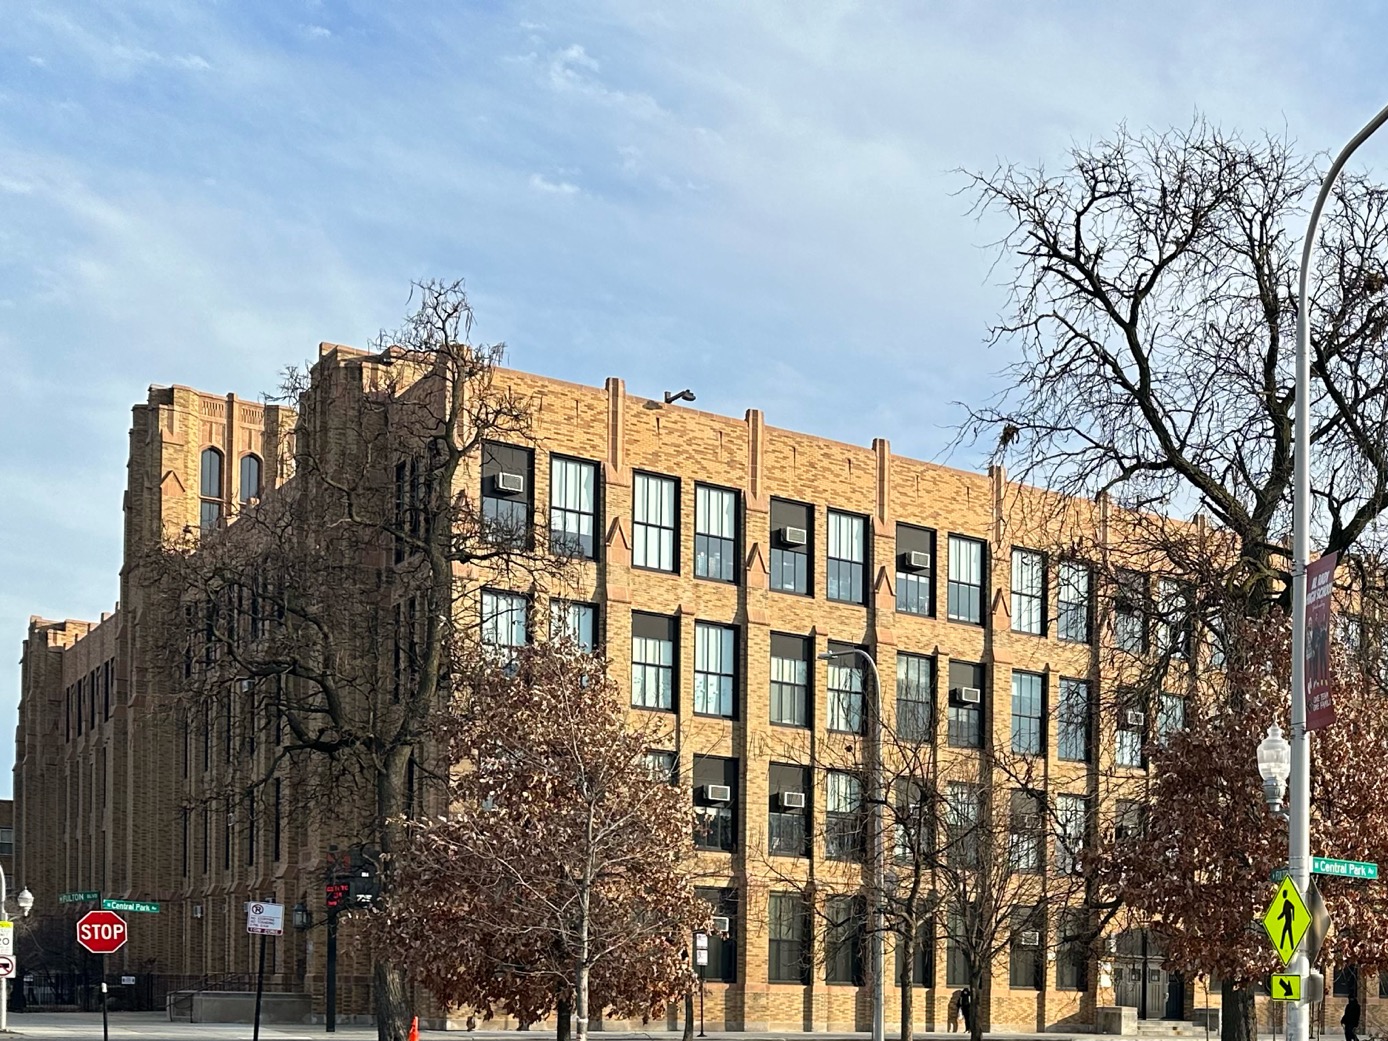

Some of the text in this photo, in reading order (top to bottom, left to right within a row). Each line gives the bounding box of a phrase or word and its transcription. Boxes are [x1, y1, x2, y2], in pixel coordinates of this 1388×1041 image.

[1320, 861, 1347, 874] Central
[1348, 864, 1367, 876] Park
[62, 893, 84, 903] FULTON
[111, 901, 135, 910] Central
[135, 903, 150, 911] Park
[81, 923, 124, 941] STOP
